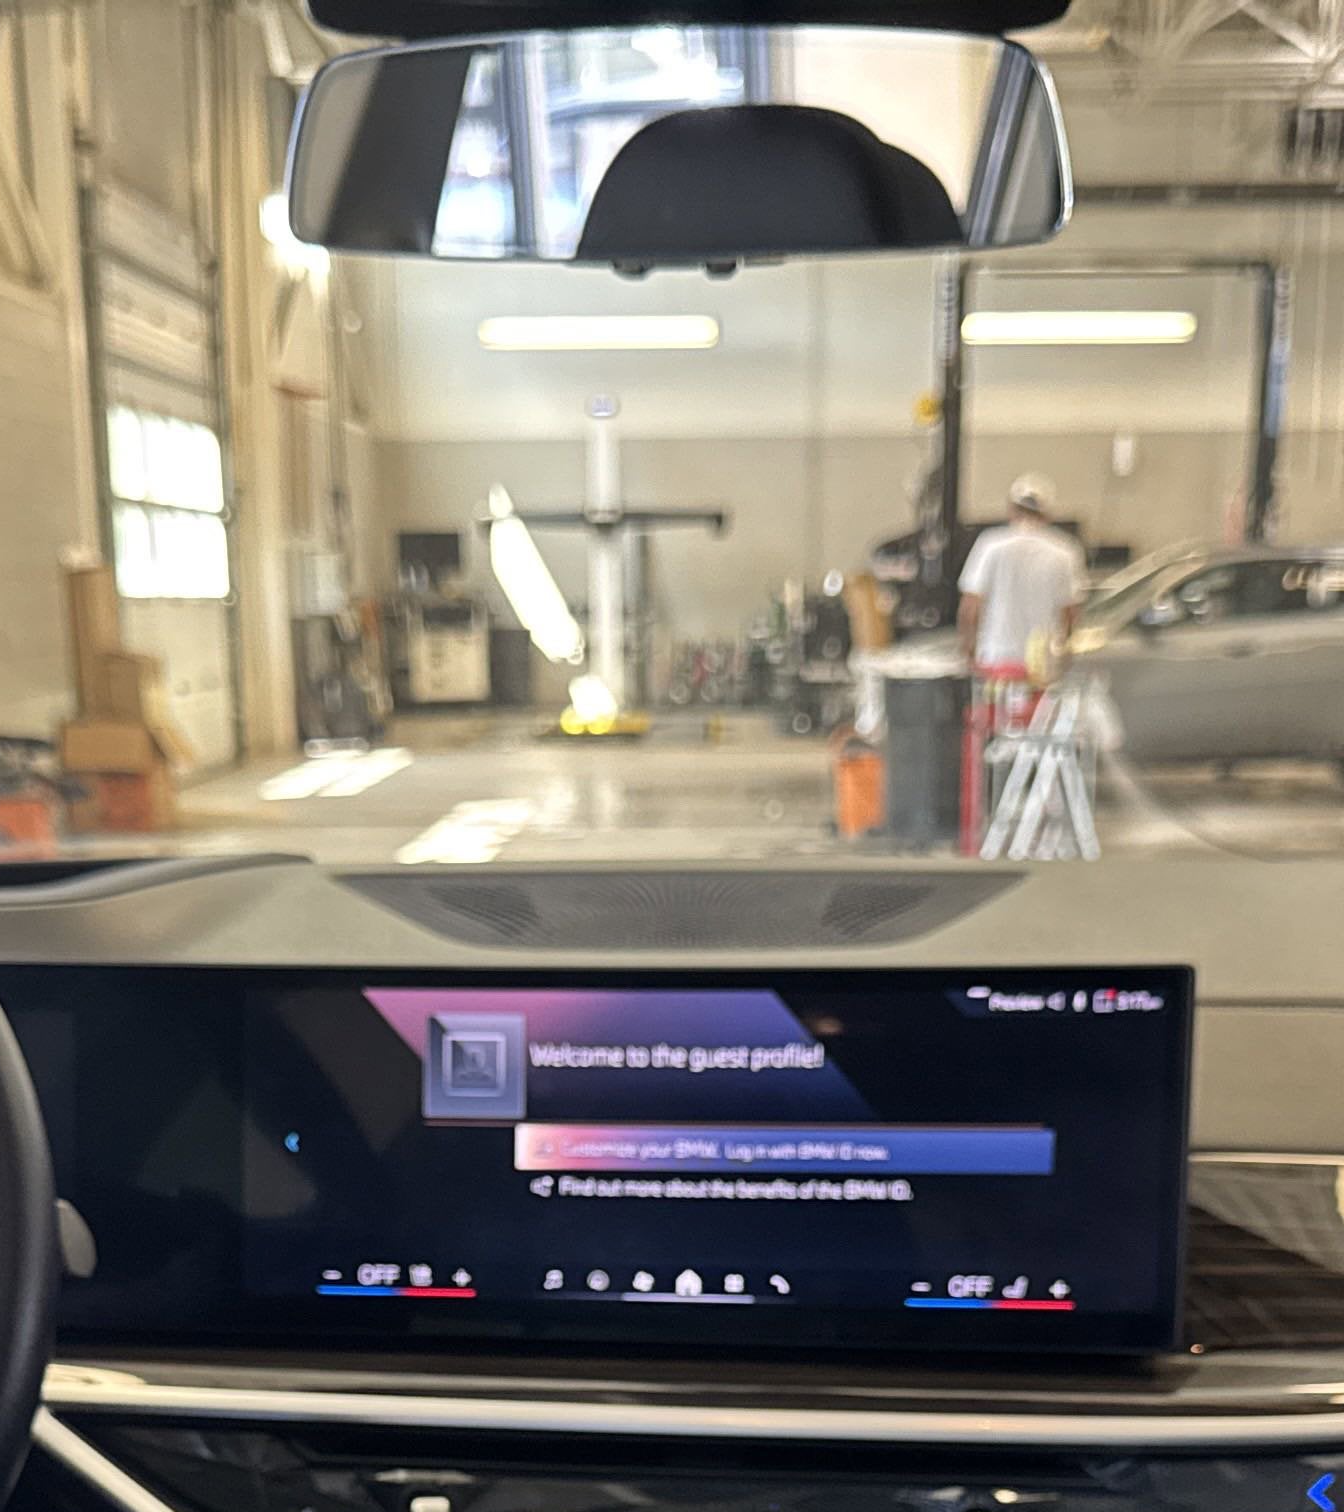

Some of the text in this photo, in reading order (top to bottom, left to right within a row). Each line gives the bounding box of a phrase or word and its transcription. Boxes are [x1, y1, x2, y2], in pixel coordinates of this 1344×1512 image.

[529, 1042, 625, 1068] Welcome
[626, 1044, 650, 1068] to
[652, 1042, 688, 1068] the
[689, 1046, 750, 1073] guest
[558, 1175, 596, 1196] Find
[597, 1179, 623, 1197] out
[624, 1179, 663, 1198] more
[664, 1178, 709, 1199] about
[709, 1178, 735, 1199] the
[736, 1178, 797, 1200] benefits
[815, 1179, 843, 1200] the
[843, 1179, 888, 1201] BMW
[357, 1263, 401, 1287] OFF
[948, 1275, 994, 1298] OFF
